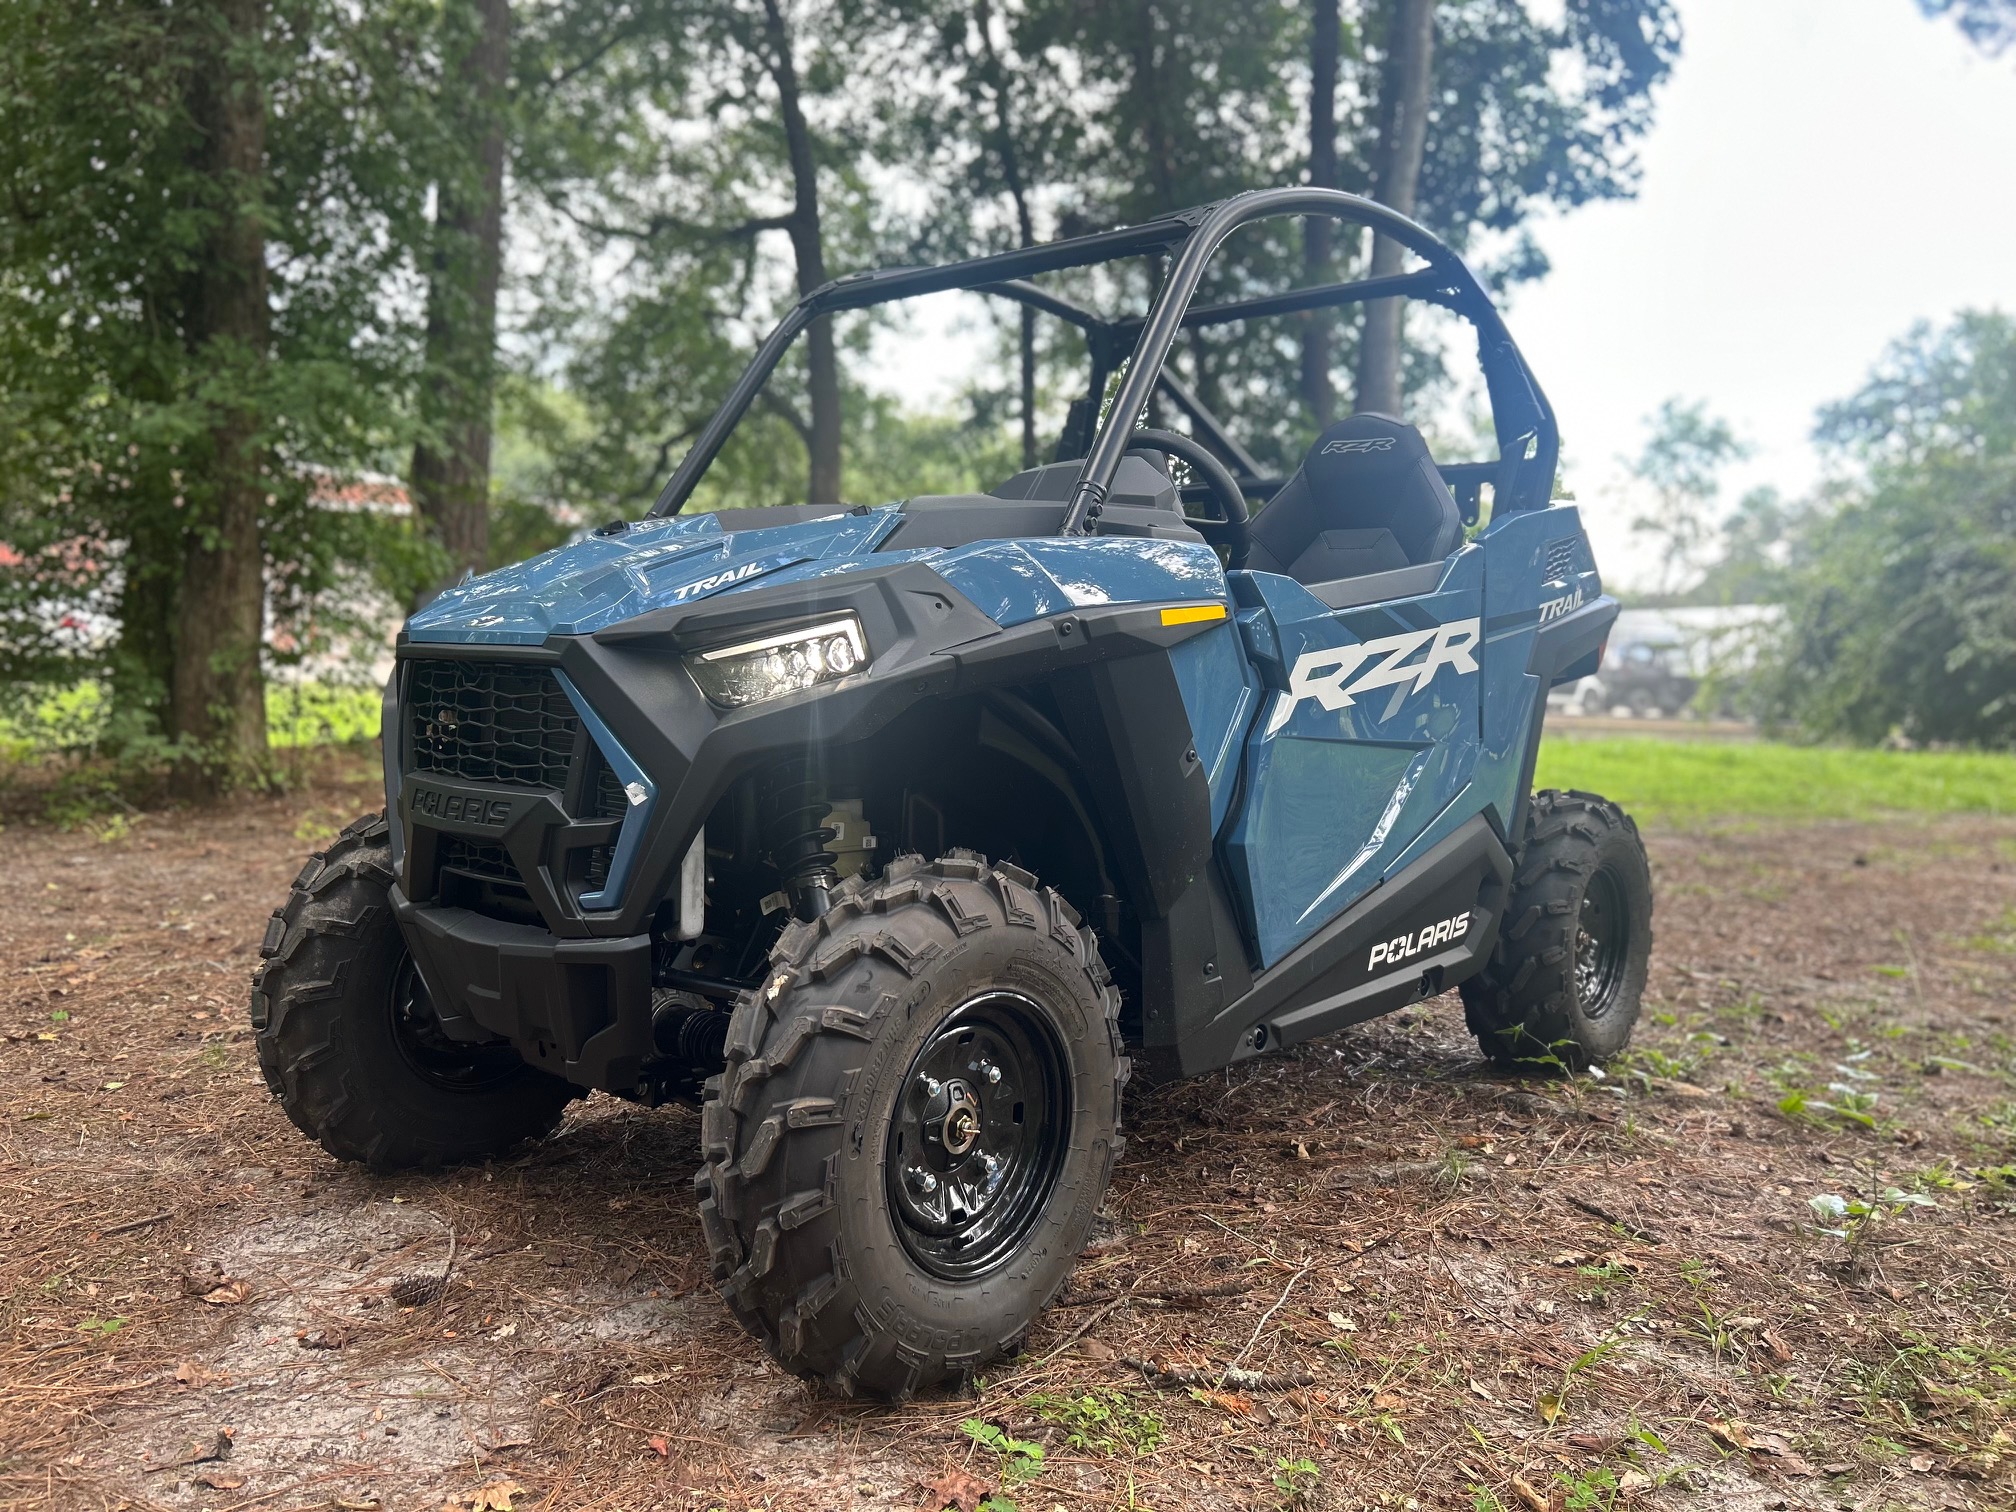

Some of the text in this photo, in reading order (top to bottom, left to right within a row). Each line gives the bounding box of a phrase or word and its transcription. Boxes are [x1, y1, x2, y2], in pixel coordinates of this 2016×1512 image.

[1320, 436, 1396, 455] RZR
[673, 560, 763, 600] TRAIL
[1538, 587, 1585, 623] TRAIL
[1267, 617, 1481, 736] RZR
[411, 787, 512, 829] POLARIS
[1367, 911, 1471, 972] POLARIS
[876, 1296, 964, 1352] POLARIS
